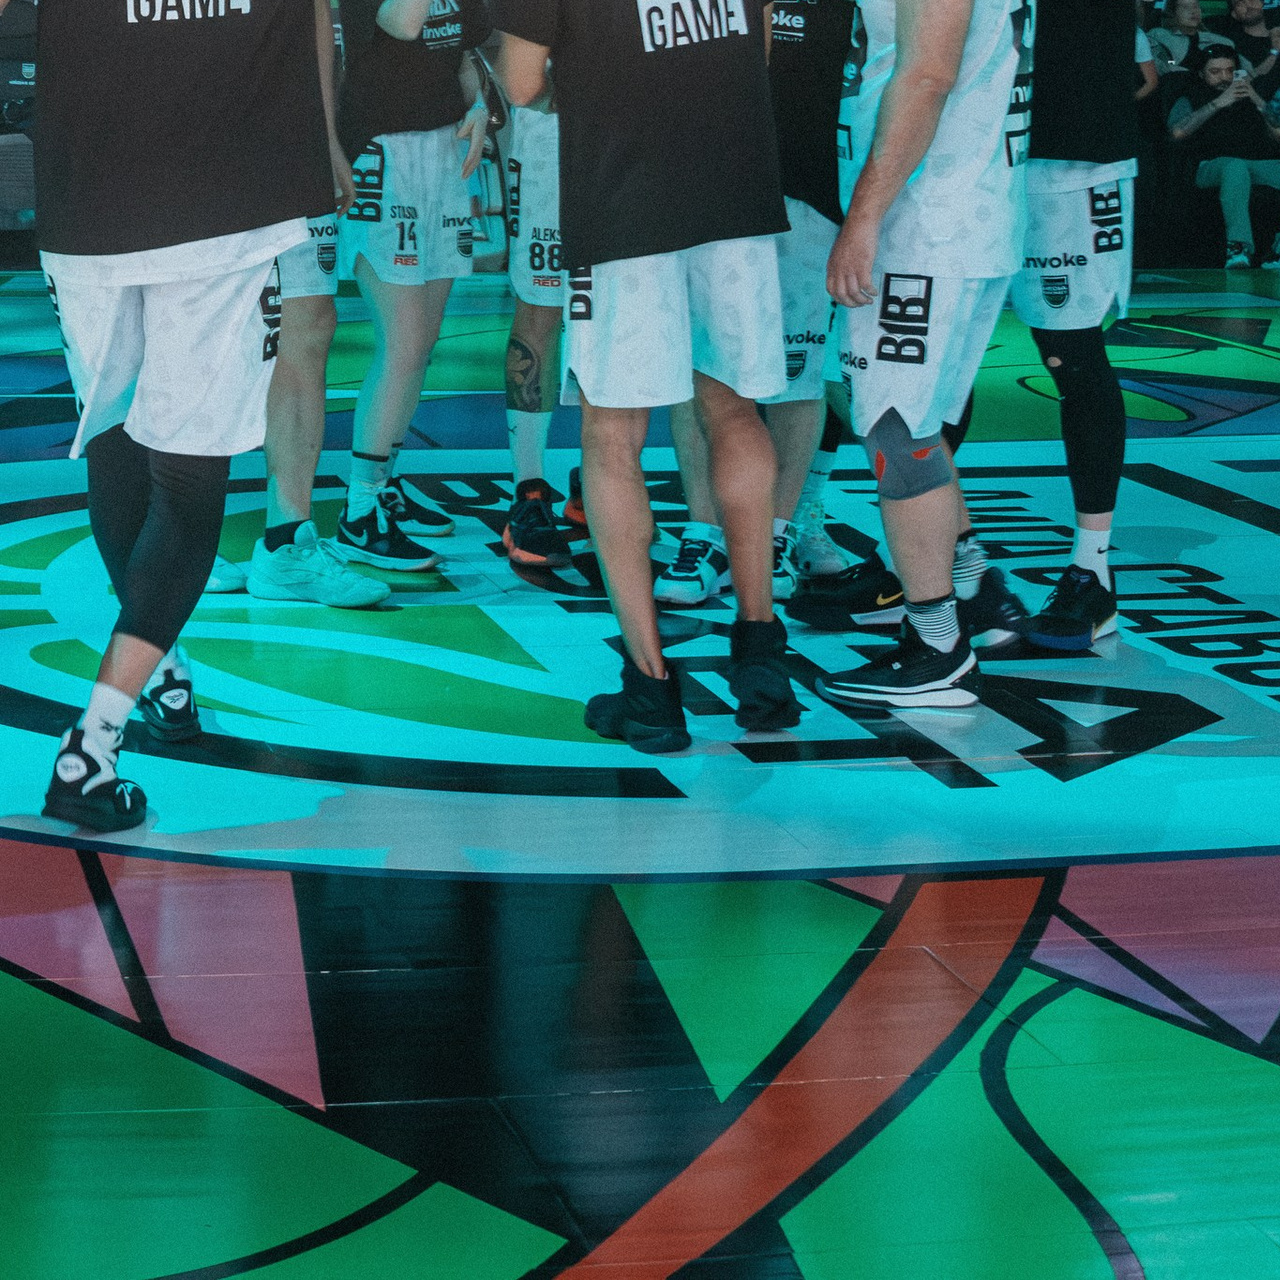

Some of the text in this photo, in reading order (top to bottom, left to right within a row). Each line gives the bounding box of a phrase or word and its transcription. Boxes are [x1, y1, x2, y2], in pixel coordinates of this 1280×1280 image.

[422, 22, 462, 39] invoke
[395, 221, 417, 250] 14
[529, 242, 563, 272] 88
[533, 279, 561, 287] RED
